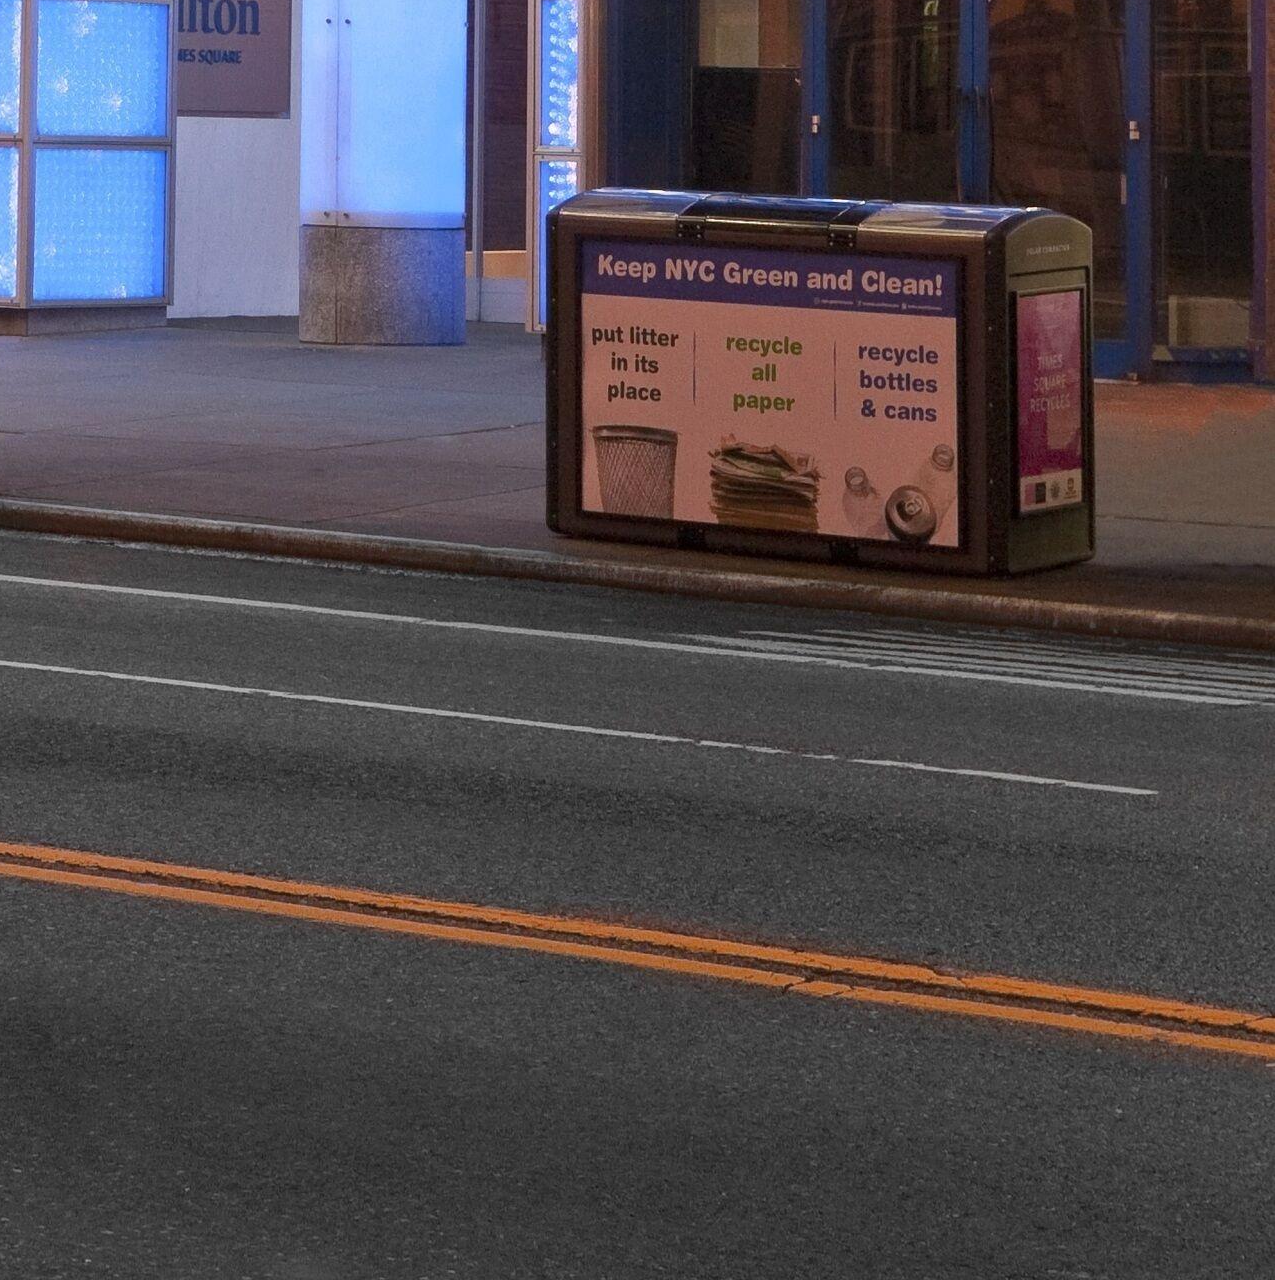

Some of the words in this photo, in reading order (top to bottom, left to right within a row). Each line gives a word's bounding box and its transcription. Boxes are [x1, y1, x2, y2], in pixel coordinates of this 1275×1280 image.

[198, 49, 242, 65] SQUARE
[598, 254, 656, 283] Keep
[665, 257, 715, 282] NYC
[723, 262, 798, 288] Green
[806, 269, 853, 290] and
[861, 270, 943, 297] Clean!
[591, 326, 624, 345] put
[630, 326, 679, 347] litter
[726, 334, 803, 357] recycle
[611, 352, 627, 371] in
[634, 352, 659, 374] its
[858, 342, 939, 367] recycle
[751, 363, 777, 381] all
[859, 370, 938, 393] bottles
[607, 381, 661, 402] place
[1033, 374, 1067, 394] SQUARE
[733, 391, 795, 413] paper
[860, 398, 877, 418] &
[884, 401, 938, 422] cans
[1029, 393, 1071, 413] RECYCLES
